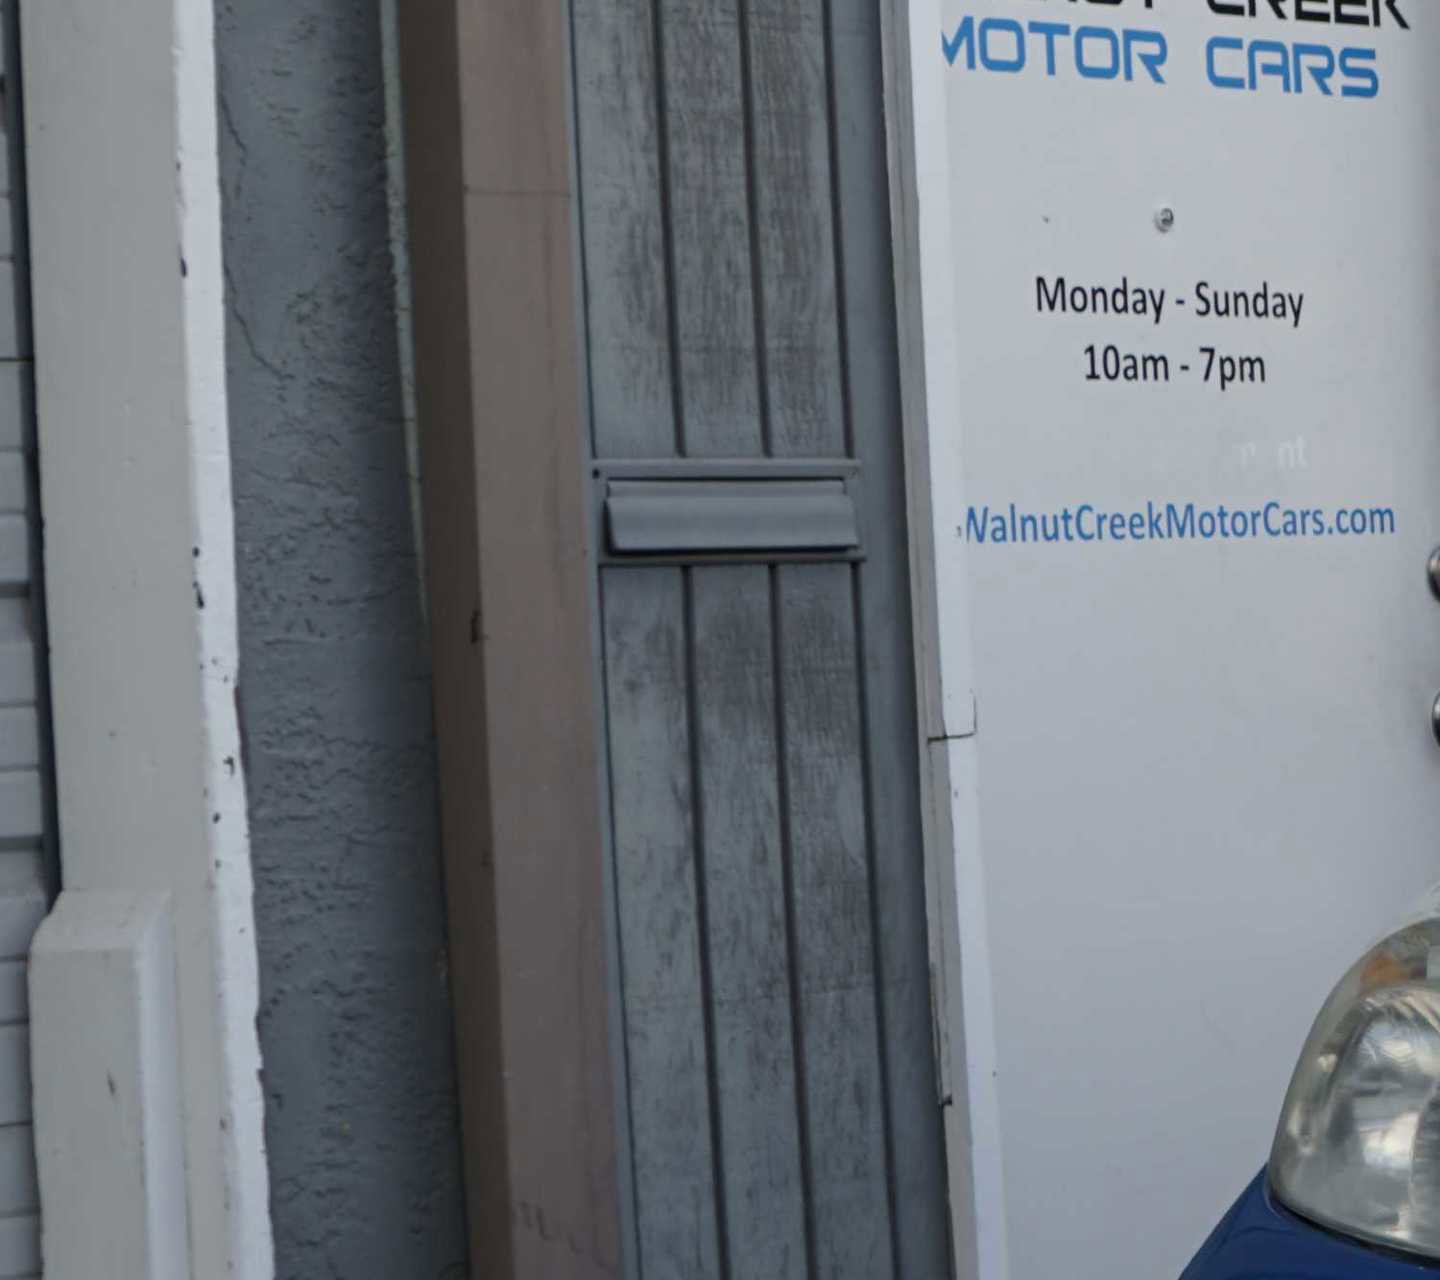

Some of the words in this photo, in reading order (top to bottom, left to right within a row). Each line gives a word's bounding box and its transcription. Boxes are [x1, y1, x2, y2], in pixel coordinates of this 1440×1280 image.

[941, 15, 1168, 85] MOTOR
[1205, 36, 1381, 99] CARS
[1035, 276, 1166, 325] Monday
[1194, 280, 1304, 328] Sunday
[1084, 343, 1170, 382] 10am
[1198, 346, 1266, 391] 7pm
